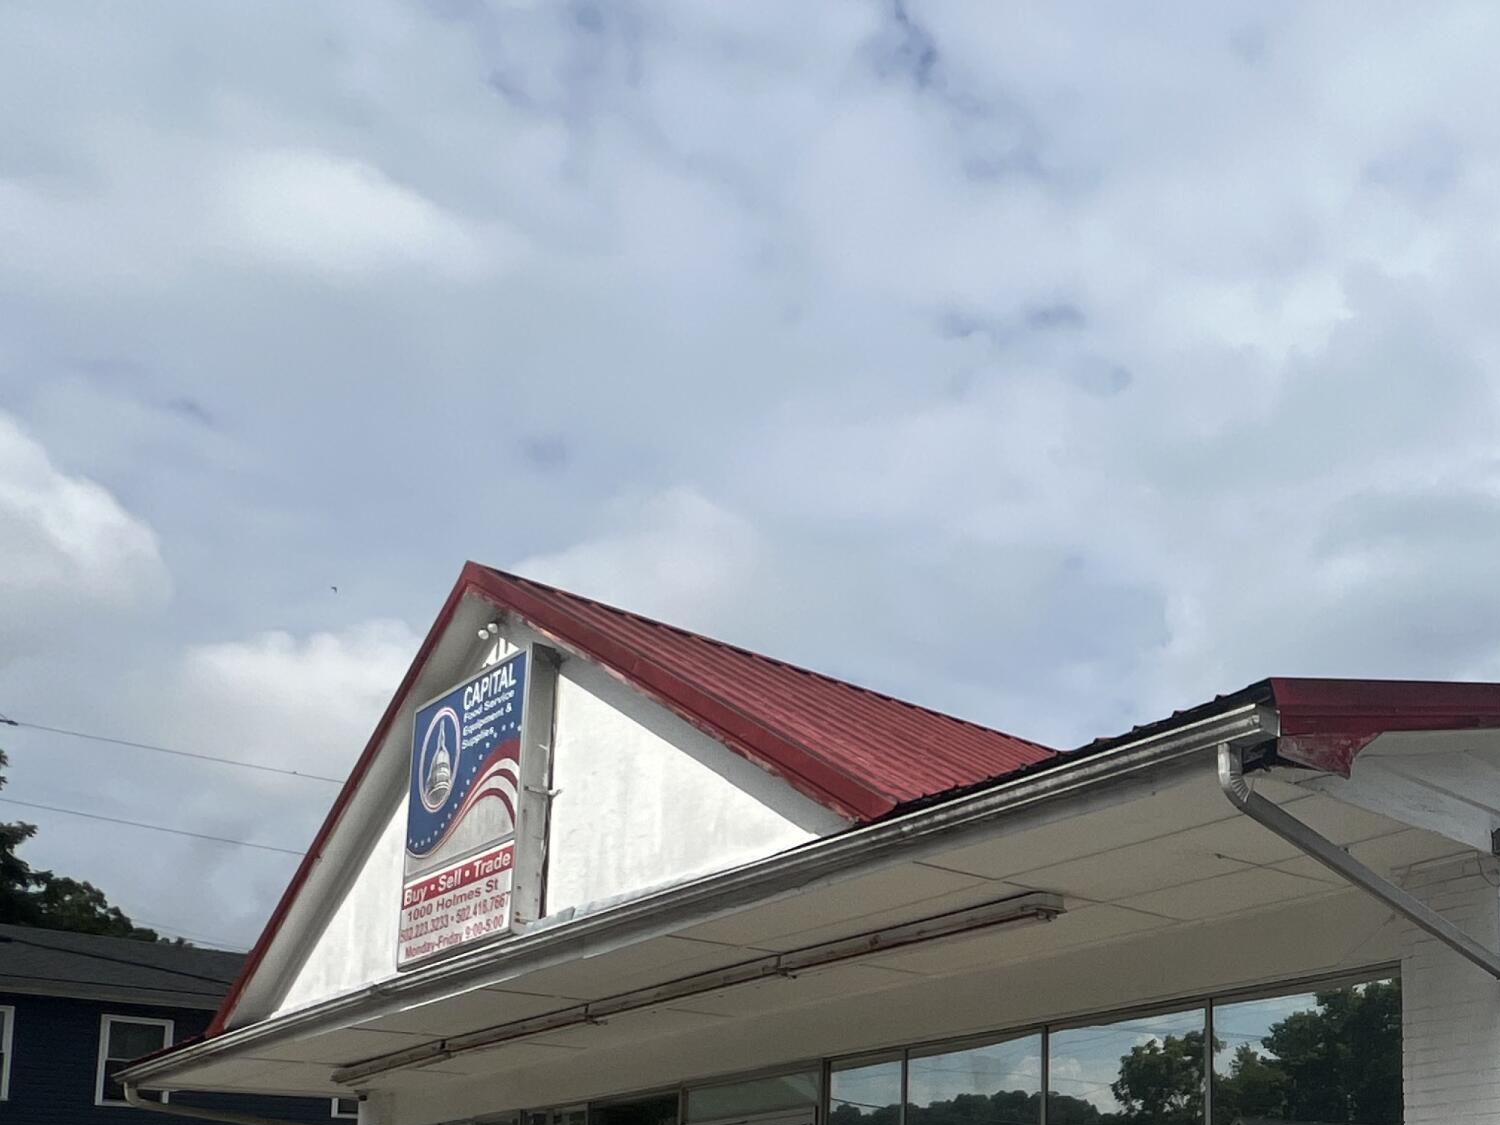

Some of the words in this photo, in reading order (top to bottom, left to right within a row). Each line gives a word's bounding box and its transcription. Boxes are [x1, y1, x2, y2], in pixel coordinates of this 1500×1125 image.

[464, 663, 516, 711] CAPITAL
[464, 703, 483, 723] Food
[484, 690, 515, 711] Service
[404, 886, 427, 906] Buy
[438, 868, 462, 892] Sell
[474, 851, 511, 878] Trade
[408, 903, 433, 922] 1000
[436, 887, 482, 912] Holmes
[485, 878, 499, 893] St
